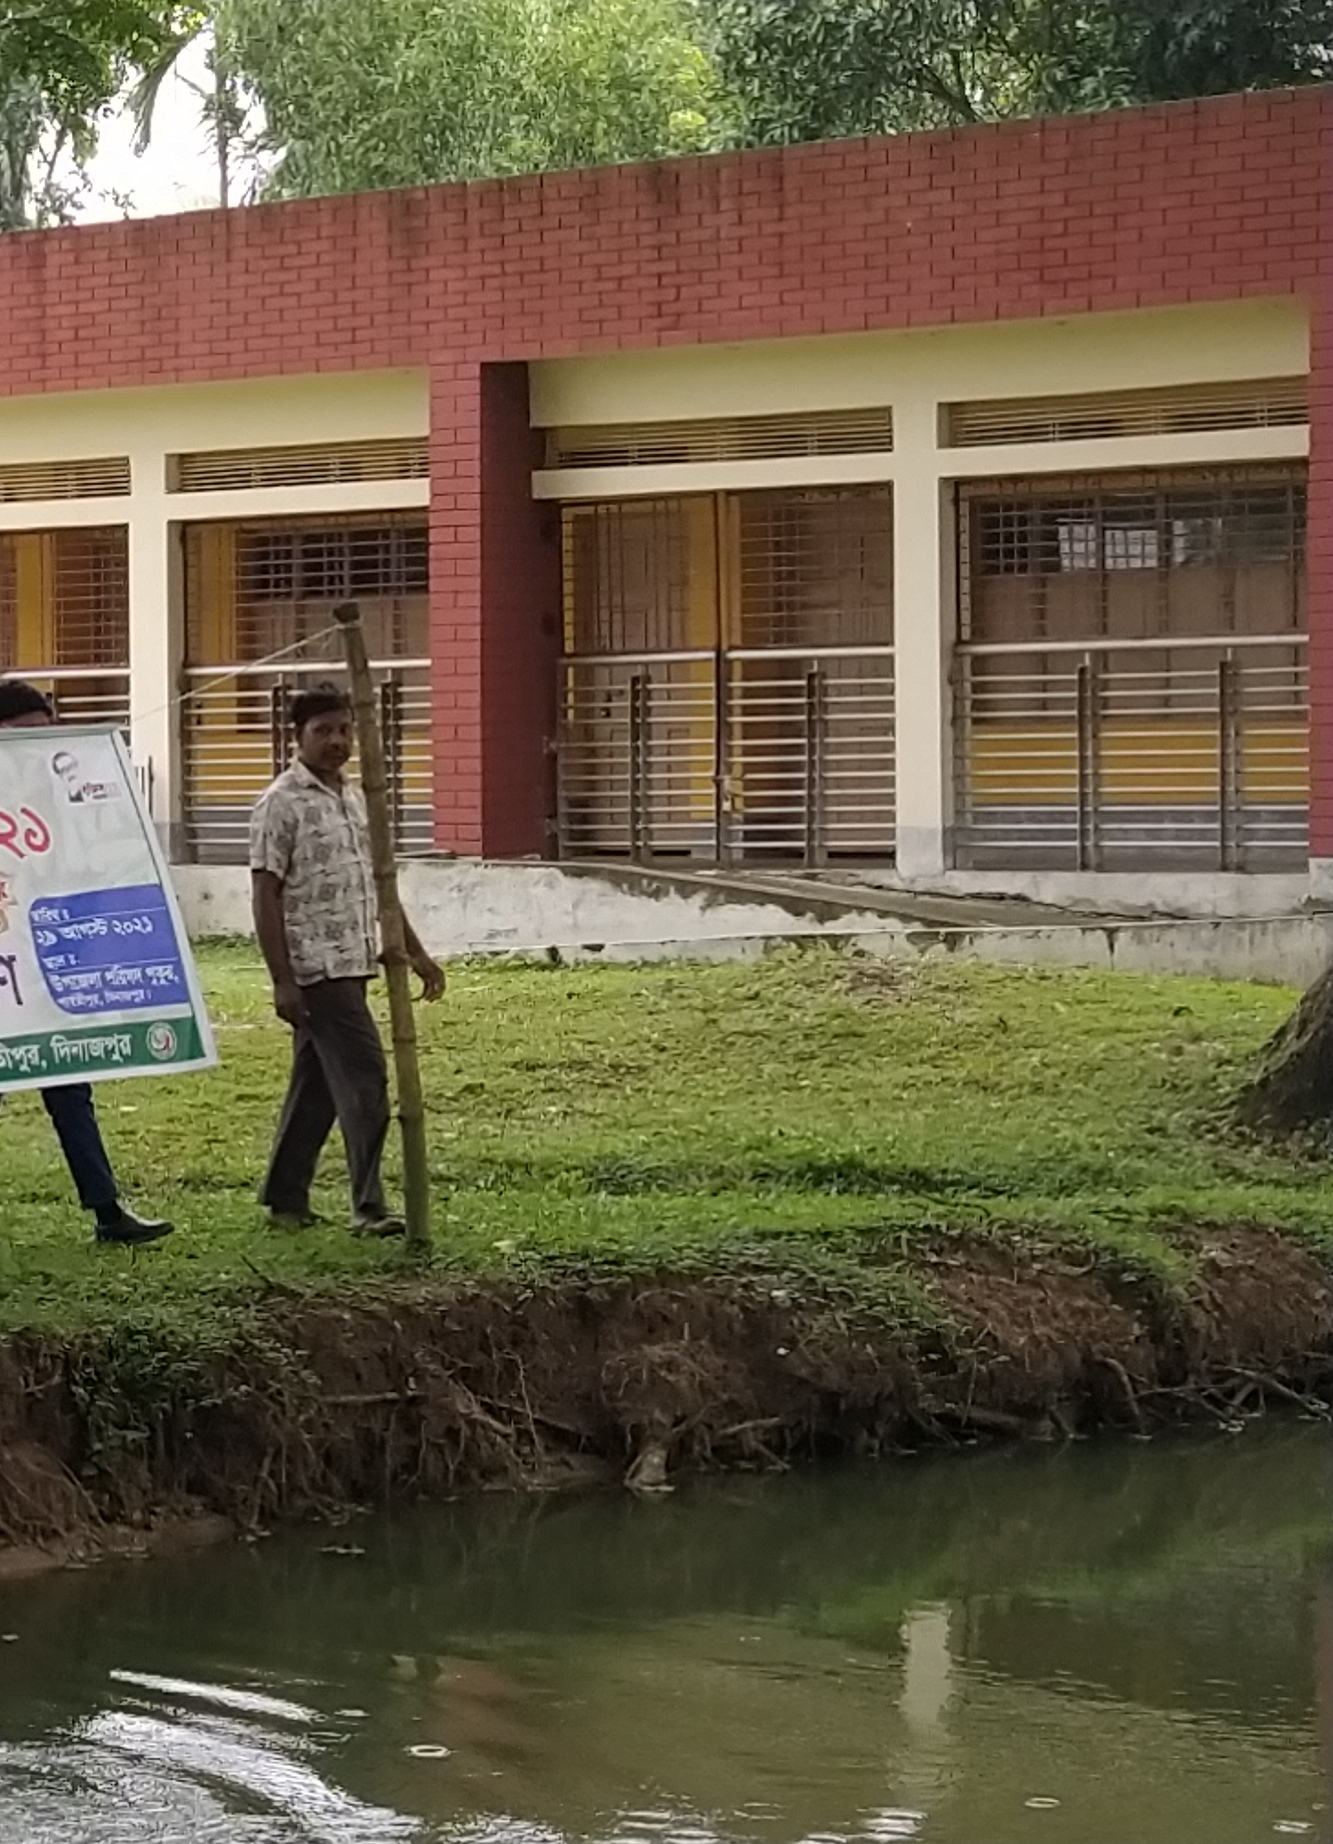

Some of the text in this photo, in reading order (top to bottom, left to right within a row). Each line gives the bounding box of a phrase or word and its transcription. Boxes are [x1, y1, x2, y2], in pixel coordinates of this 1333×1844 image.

[111, 915, 154, 937] ২০২১
[47, 971, 103, 993] উপজেলা
[104, 963, 145, 987] পরিষদ
[49, 1033, 133, 1066] দিনাজপুর
